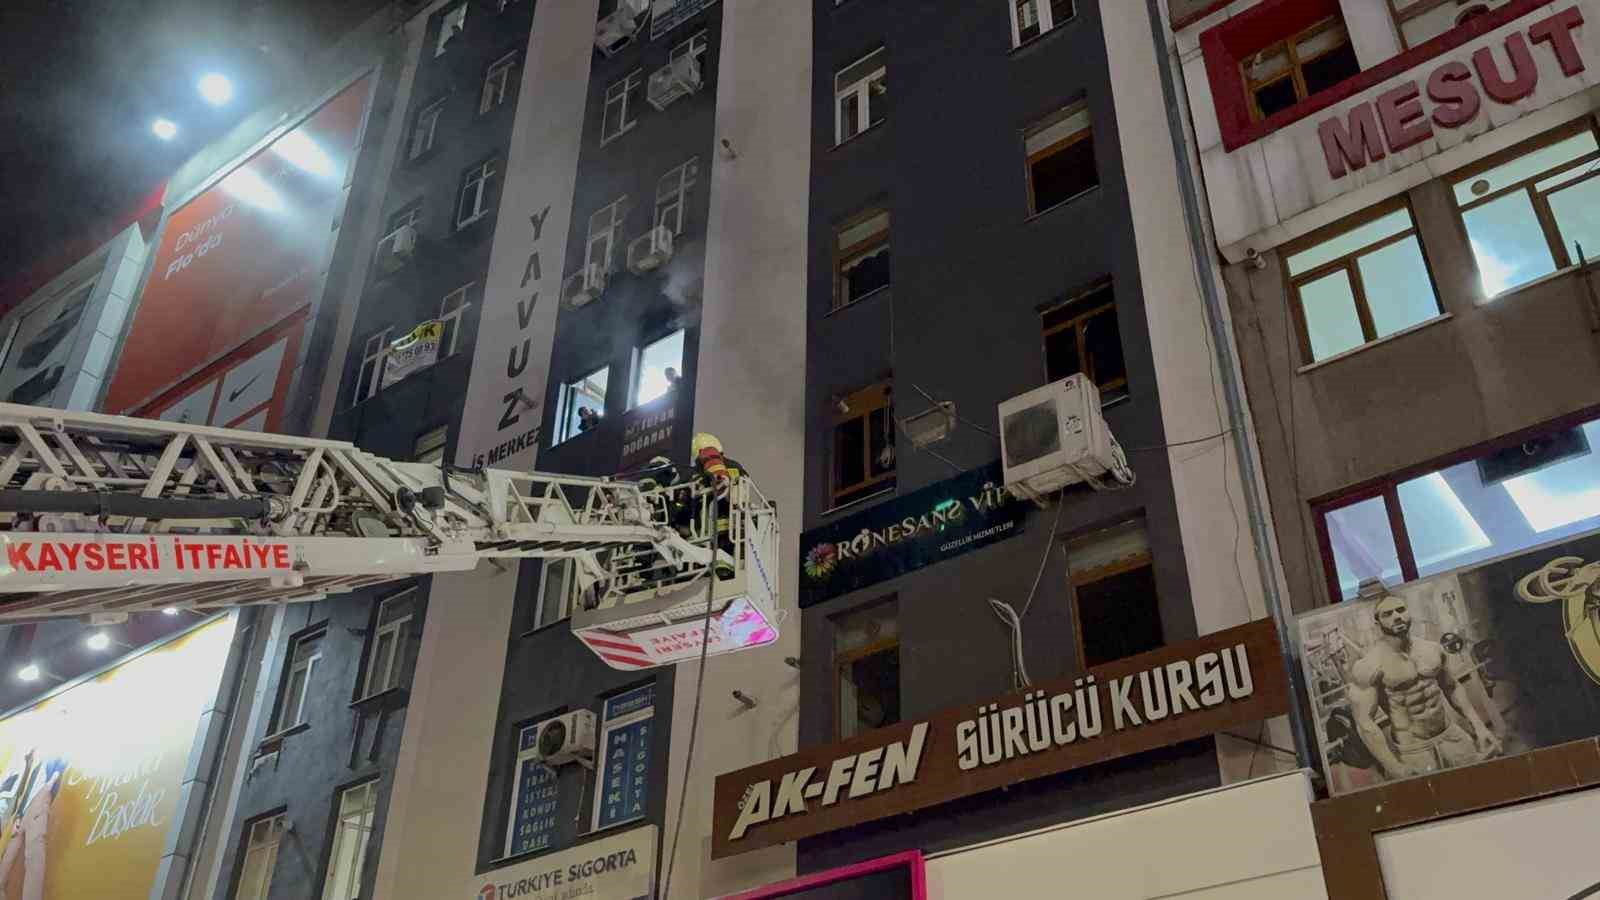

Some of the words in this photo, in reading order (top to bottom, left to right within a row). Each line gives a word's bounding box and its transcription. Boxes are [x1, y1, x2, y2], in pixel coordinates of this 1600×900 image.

[1318, 5, 1585, 180] MESUT
[497, 206, 550, 432] YAVUZ
[7, 537, 160, 572] KAYSERİ
[174, 537, 290, 570] İTFAİYE
[728, 722, 929, 840] AK-FEN
[956, 674, 1102, 770] SÜRÜCÜ
[1109, 643, 1254, 730] KURSU
